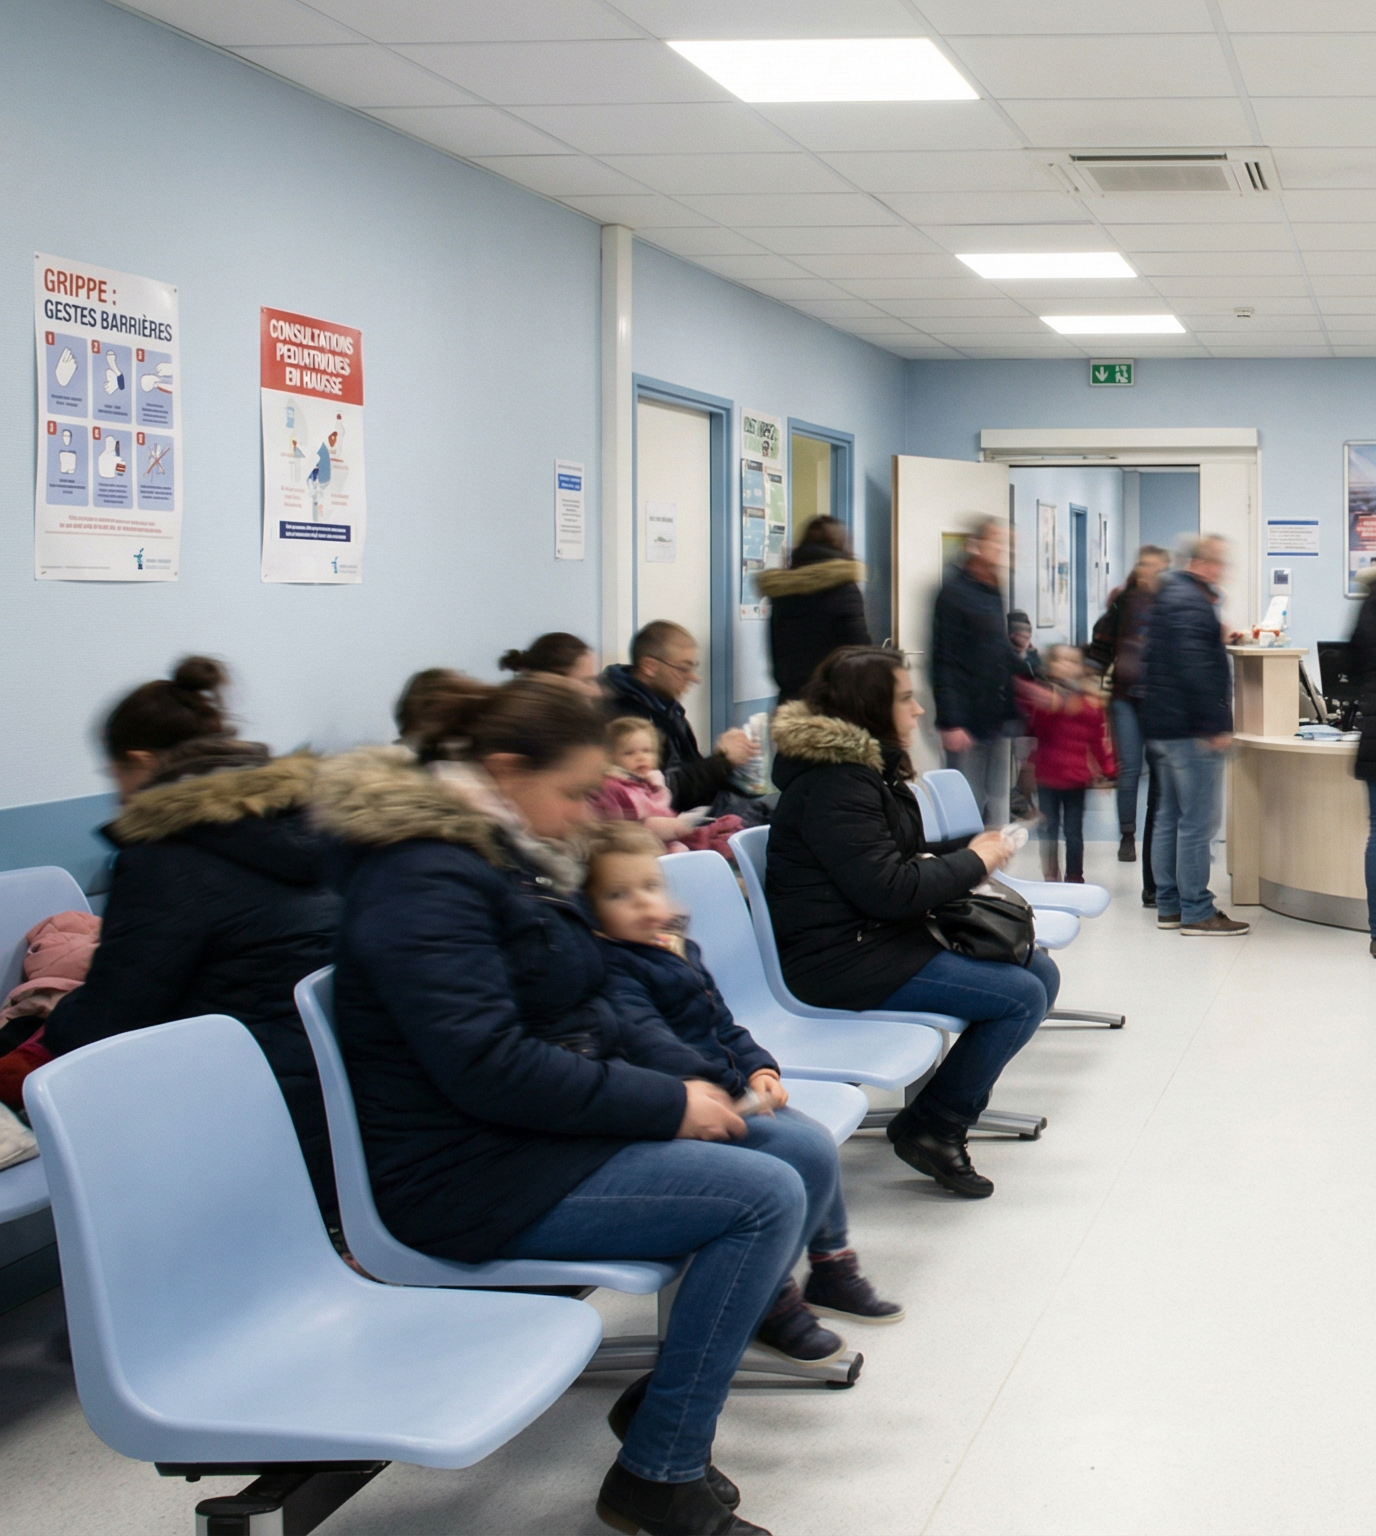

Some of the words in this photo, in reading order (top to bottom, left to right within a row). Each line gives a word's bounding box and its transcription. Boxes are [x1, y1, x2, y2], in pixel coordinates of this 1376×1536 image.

[44, 268, 107, 303] GRIPPE
[44, 299, 97, 328] GESTES
[100, 314, 173, 342] BARRIÈRES
[269, 318, 354, 355] CONSULTATIONS
